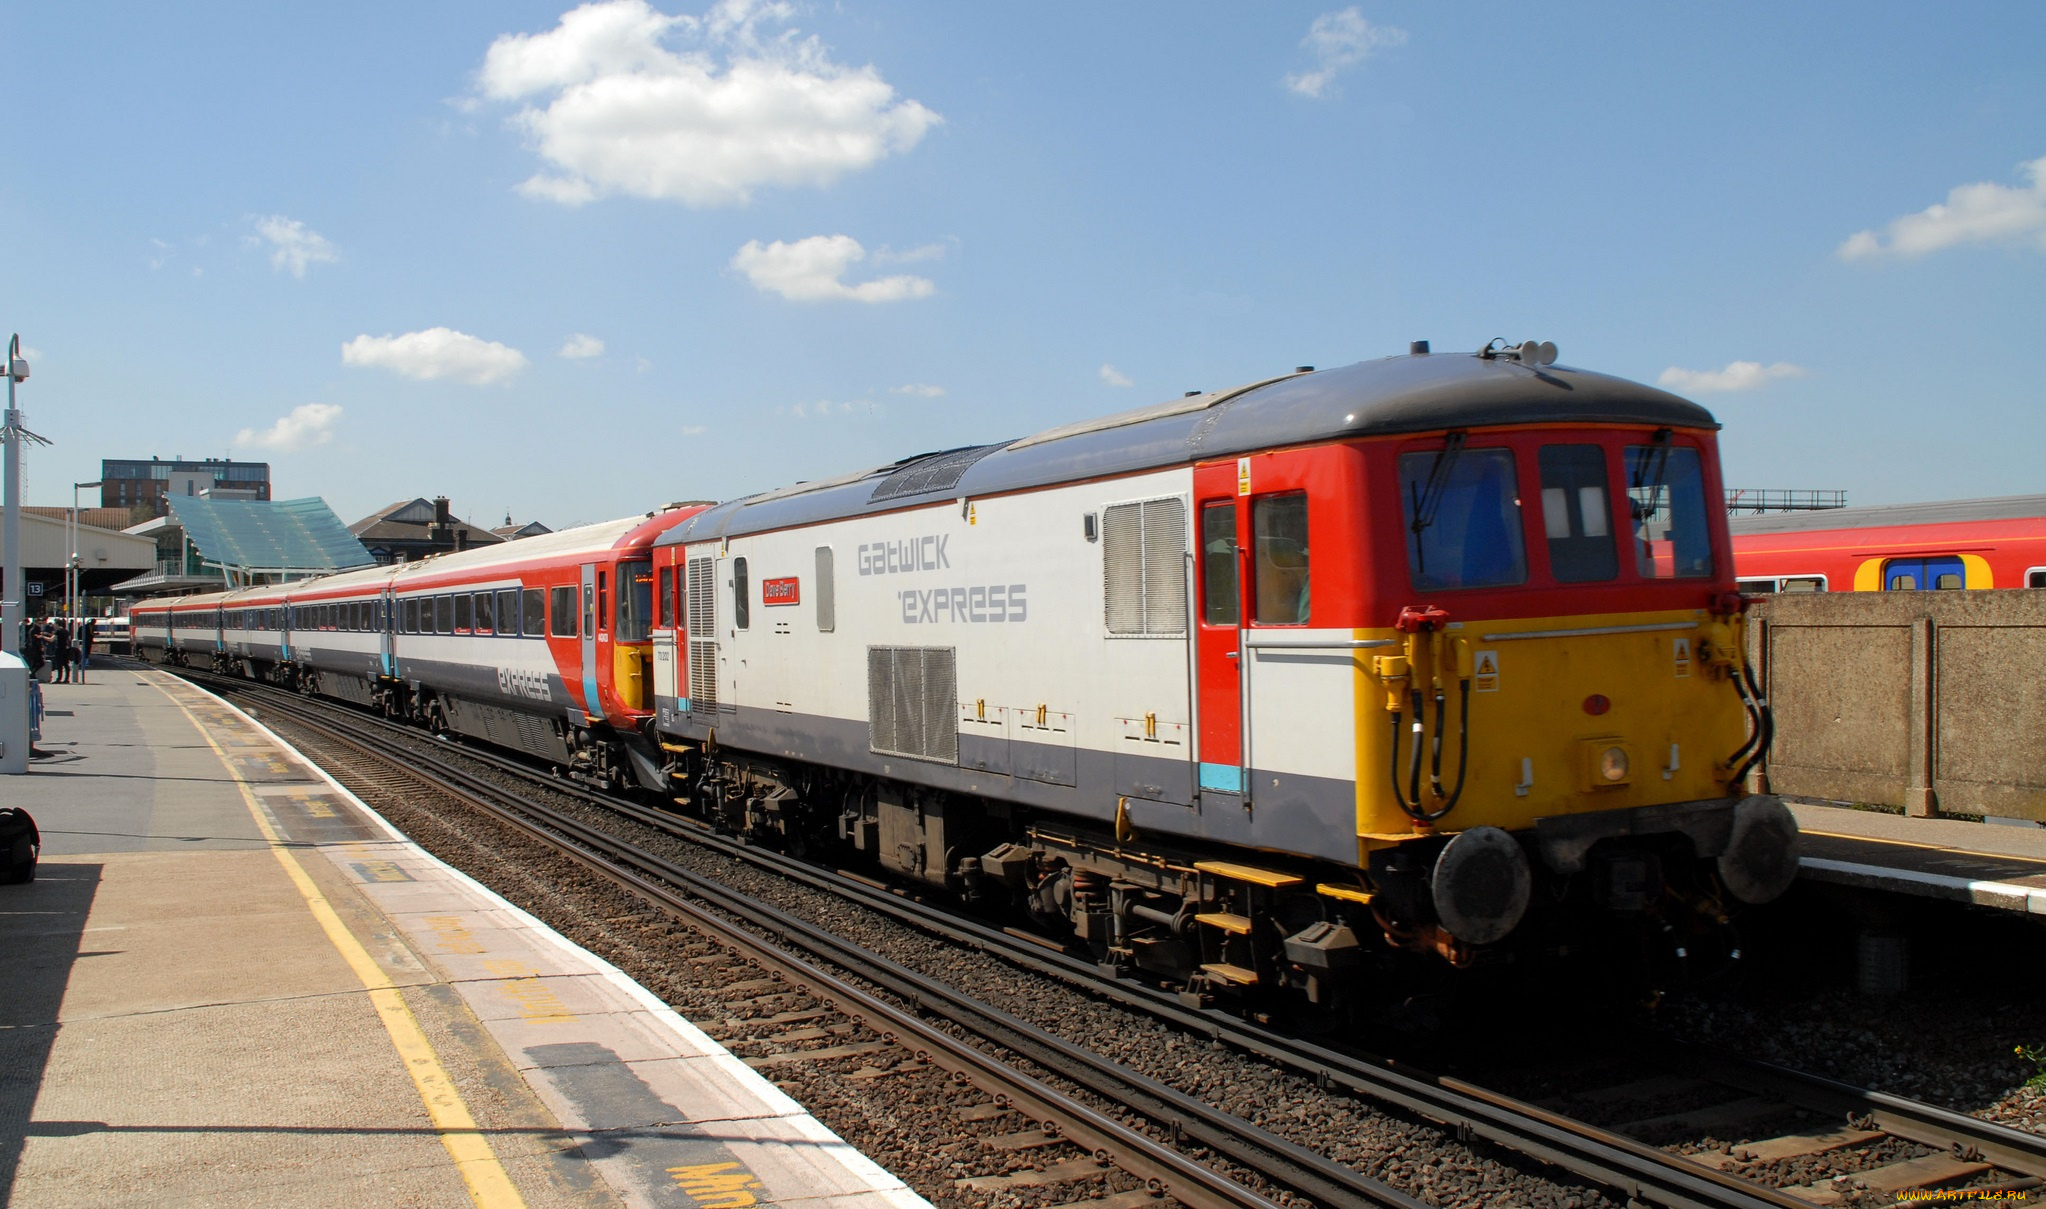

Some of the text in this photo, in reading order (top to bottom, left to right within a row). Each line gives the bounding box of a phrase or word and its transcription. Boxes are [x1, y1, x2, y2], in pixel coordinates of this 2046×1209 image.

[30, 584, 41, 593] 13
[766, 580, 796, 599] Dave Berry
[902, 584, 1027, 624] EXPRESS
